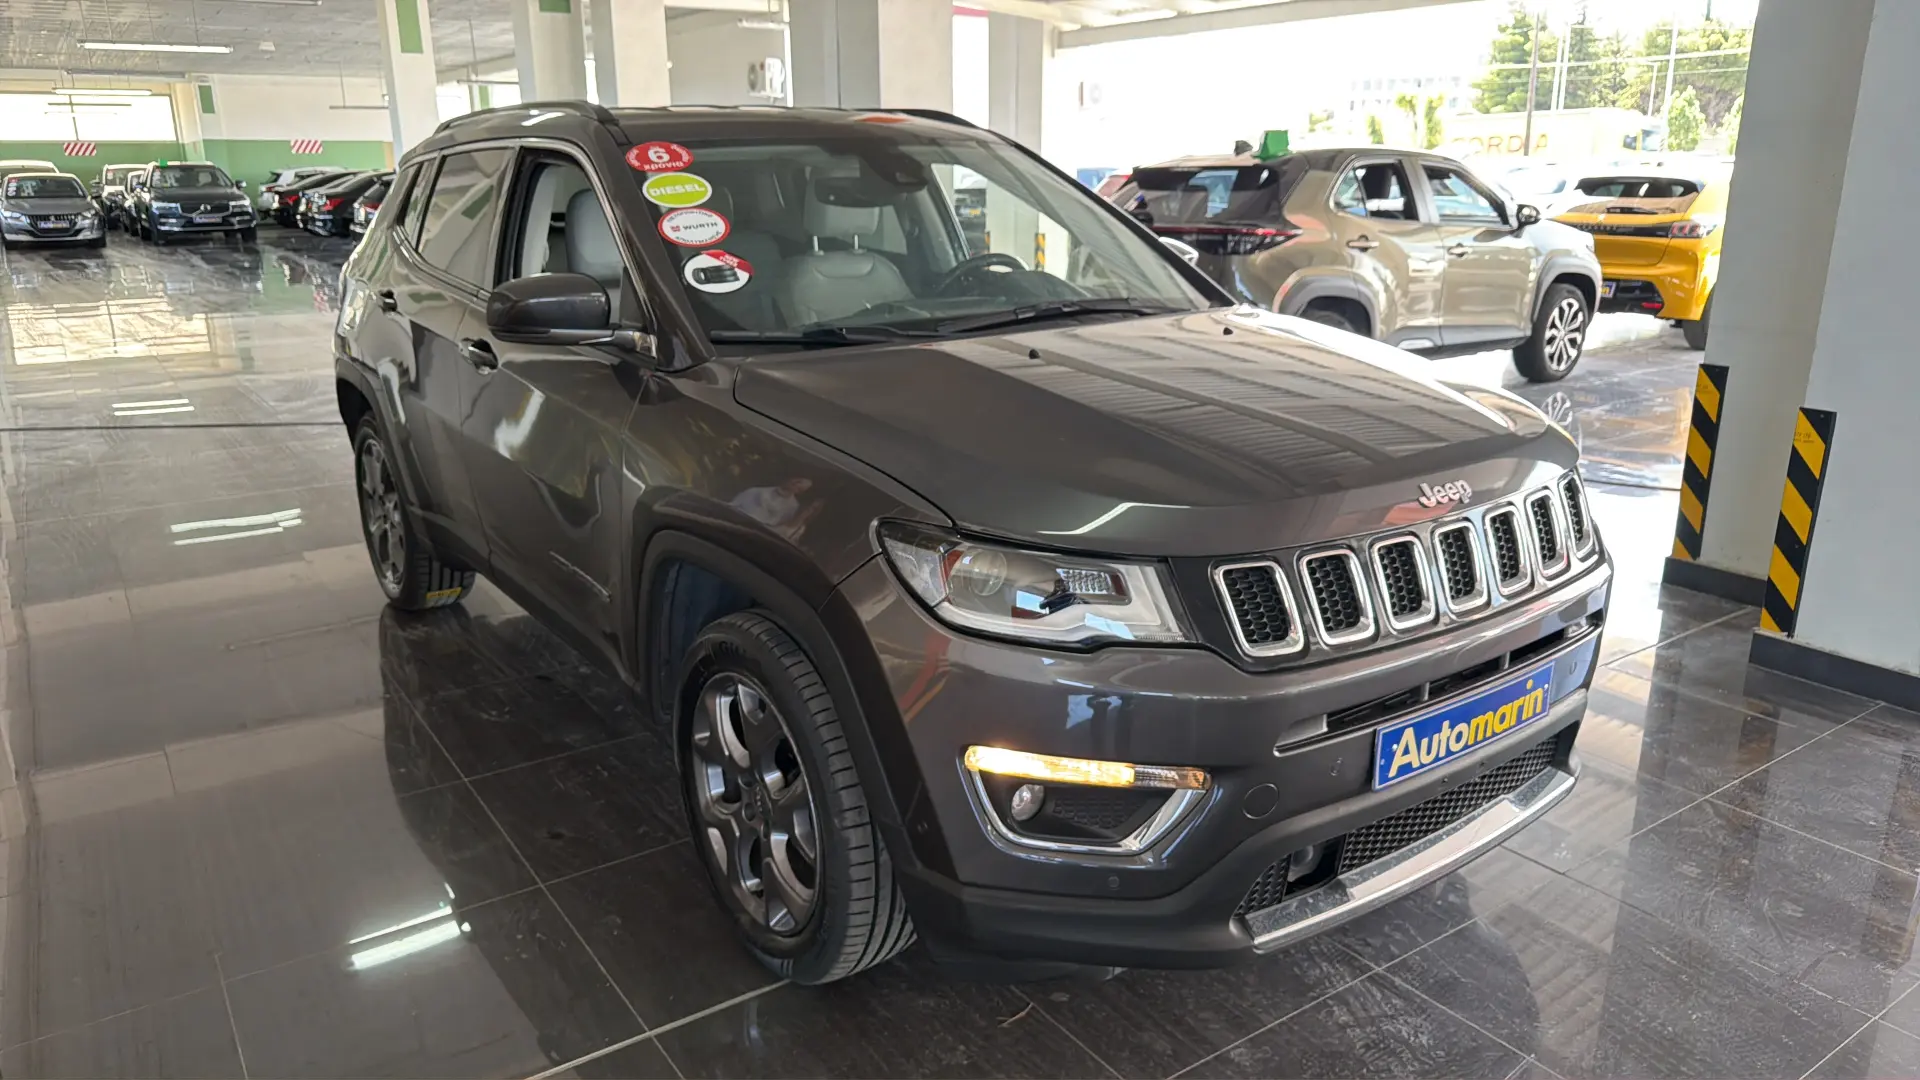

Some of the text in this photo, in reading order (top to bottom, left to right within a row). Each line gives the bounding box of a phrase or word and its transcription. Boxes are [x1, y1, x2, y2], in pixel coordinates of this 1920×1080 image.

[648, 146, 670, 163] 6
[649, 184, 705, 196] DIESEL
[1419, 480, 1472, 508] Jeep
[1388, 679, 1544, 778] Automarin
